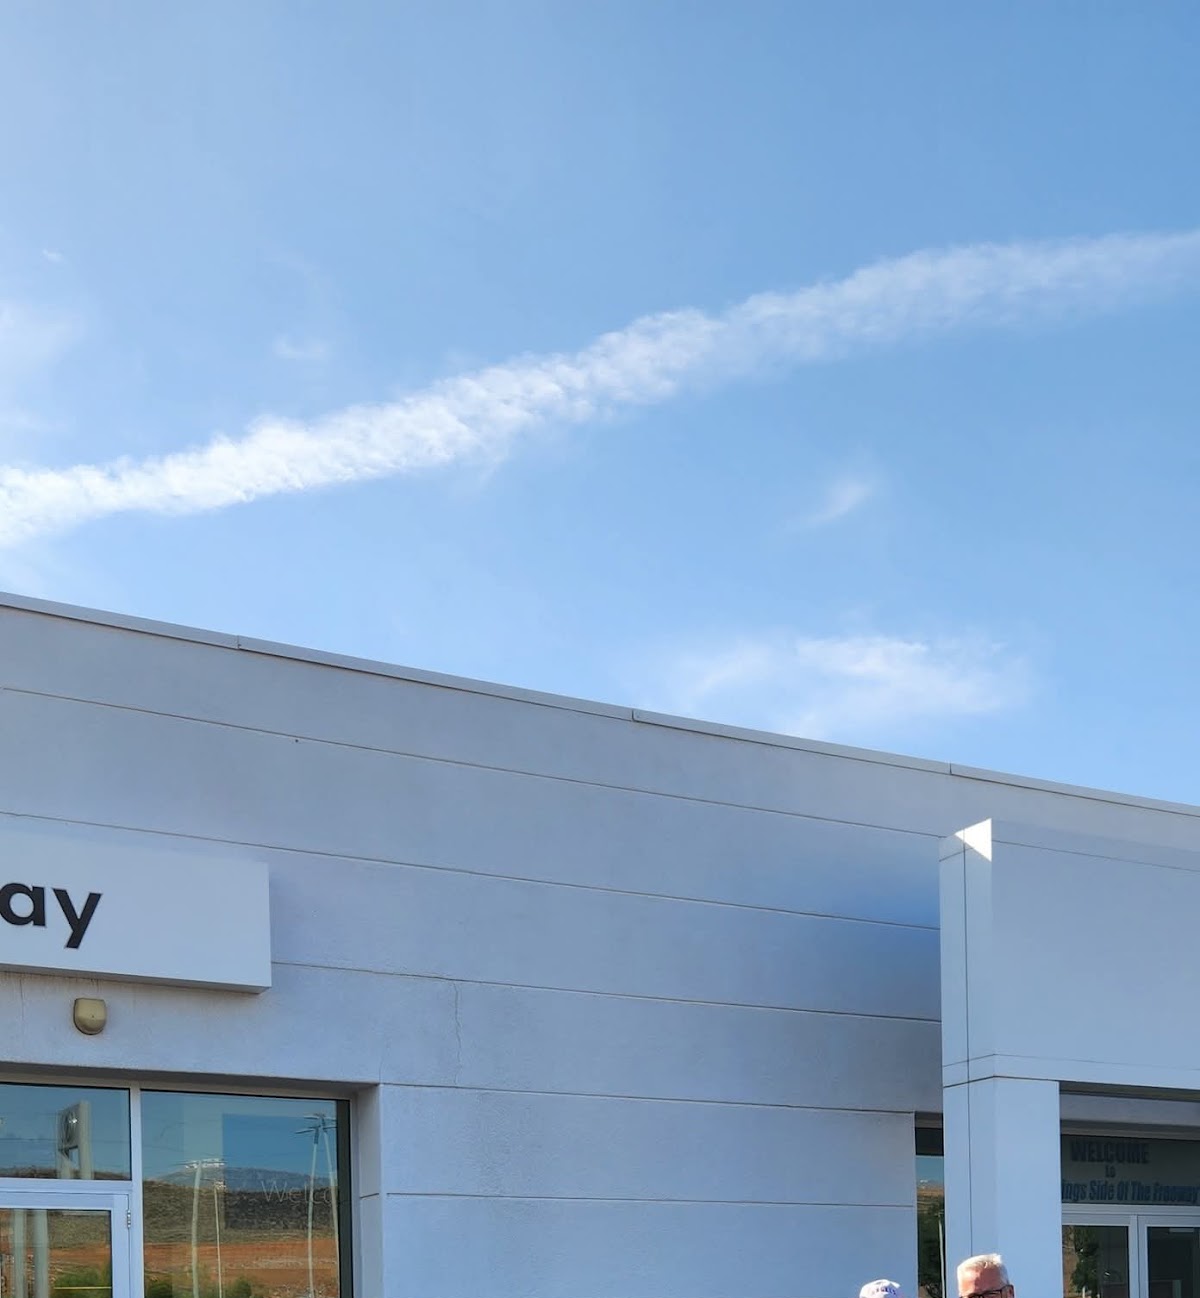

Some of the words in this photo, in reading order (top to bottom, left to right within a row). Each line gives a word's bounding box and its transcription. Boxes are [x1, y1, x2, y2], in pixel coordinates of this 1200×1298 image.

[0, 882, 103, 949] ay
[1070, 1141, 1150, 1164] WELCOME
[1089, 1180, 1114, 1200] Side
[1131, 1181, 1151, 1201] The
